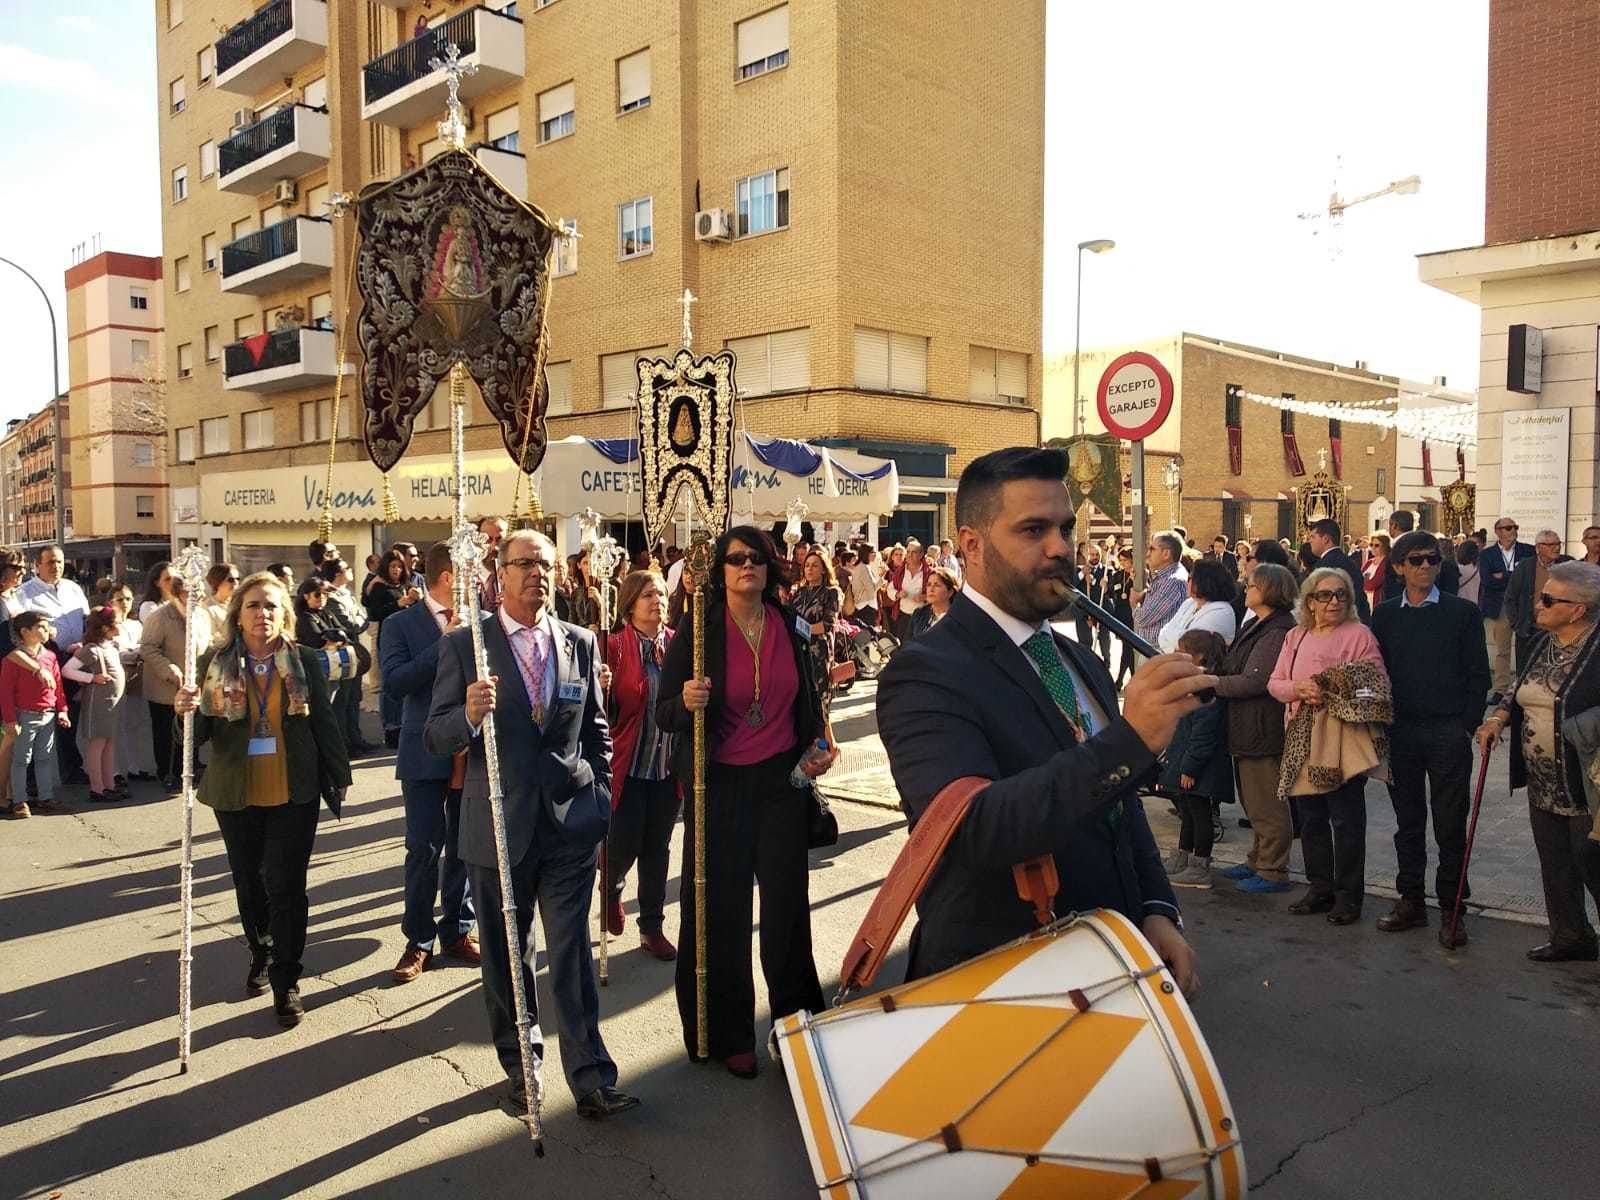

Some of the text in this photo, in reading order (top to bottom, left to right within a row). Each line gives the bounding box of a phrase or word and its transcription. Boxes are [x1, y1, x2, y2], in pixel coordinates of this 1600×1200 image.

[1108, 378, 1156, 396] EXCEPTO
[1109, 398, 1157, 415] GARAJES
[581, 470, 641, 492] CAFETE
[808, 476, 870, 497] HEDERIA
[224, 488, 276, 506] CAFETERIA
